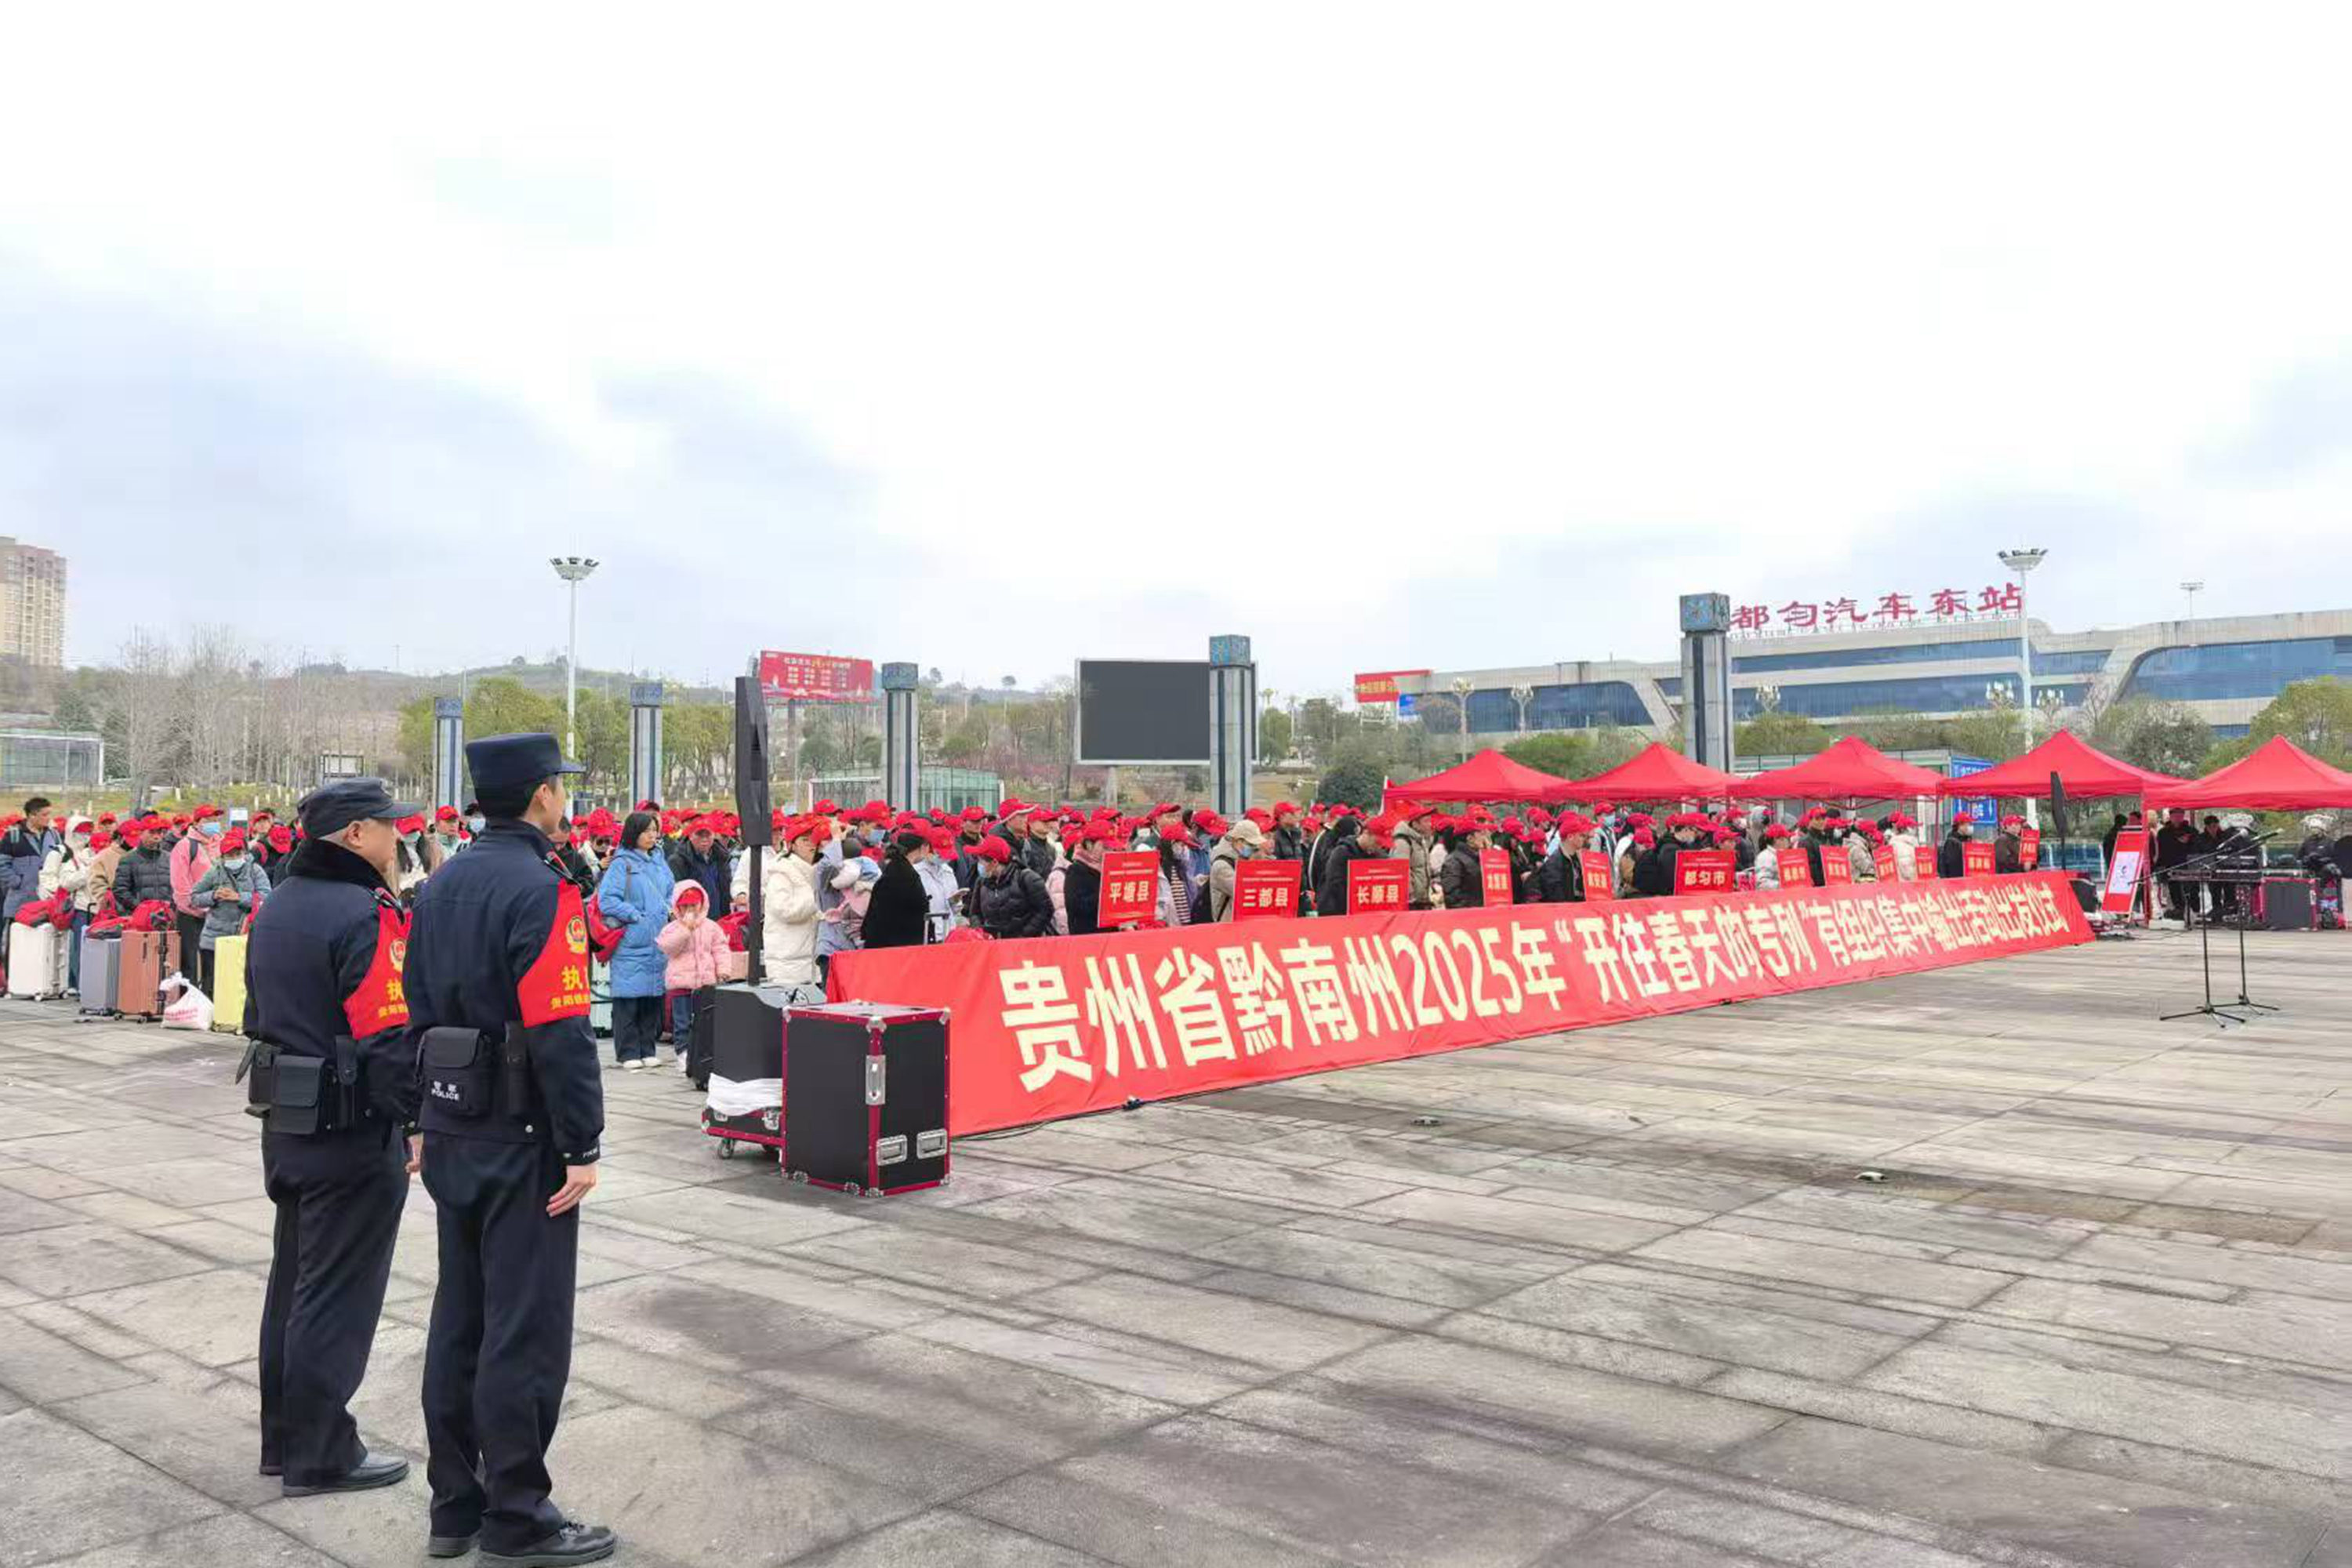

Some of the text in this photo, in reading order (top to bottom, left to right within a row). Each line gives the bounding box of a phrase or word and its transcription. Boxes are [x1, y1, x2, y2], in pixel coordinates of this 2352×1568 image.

[1730, 583, 2022, 629] 都匀汽车东站
[1685, 870, 1726, 887] 都匀市
[1109, 880, 1149, 903] 平塘县
[1243, 887, 1288, 908] 三都县
[1357, 884, 1399, 905] 长顺县
[561, 964, 590, 990] 执
[431, 1088, 459, 1100] POLICE
